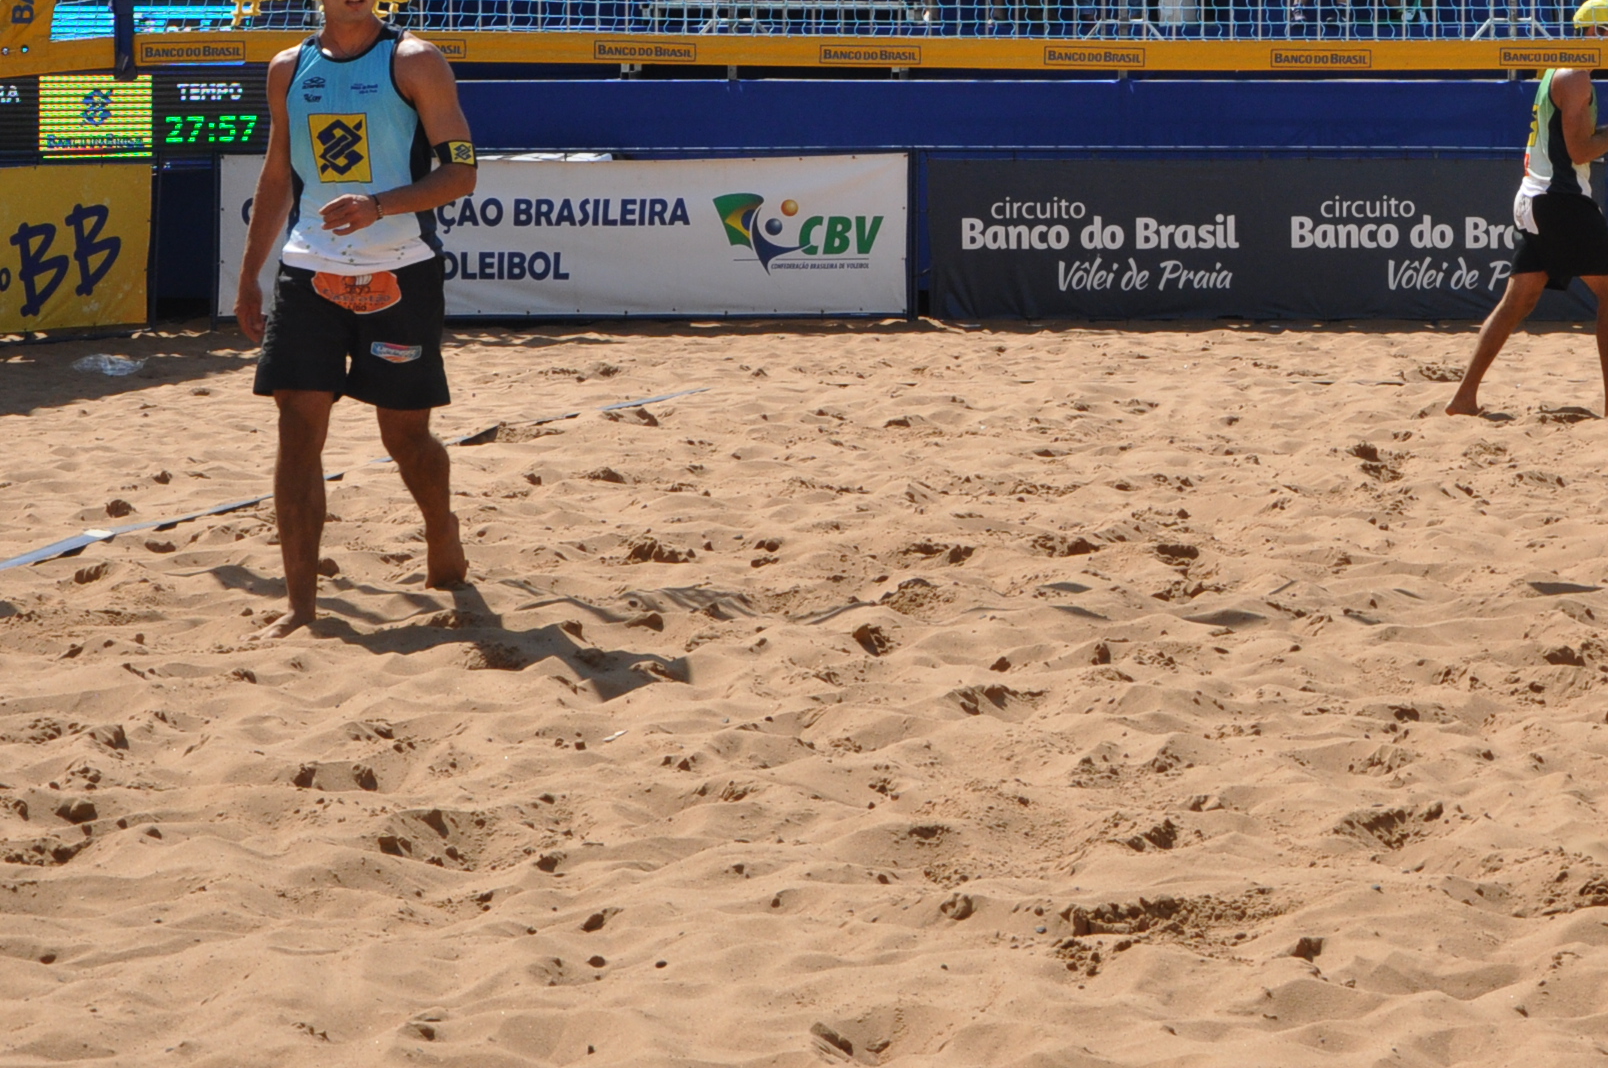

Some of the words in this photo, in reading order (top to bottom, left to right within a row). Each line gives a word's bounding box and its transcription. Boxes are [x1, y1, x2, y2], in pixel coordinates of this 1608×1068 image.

[144, 43, 185, 58] BANCO
[185, 46, 201, 59] DO
[202, 44, 242, 59] BRASIL
[597, 44, 637, 59] BANCO
[638, 47, 654, 59] DO
[654, 44, 694, 59] BRASIL
[823, 48, 863, 62] BANCO
[863, 51, 879, 62] DO
[879, 48, 919, 62] BRASIL
[1047, 50, 1086, 65] BANCO
[1087, 53, 1103, 65] DO
[1103, 50, 1142, 65] BRASIL
[1274, 51, 1313, 67] BANCO
[1314, 54, 1330, 67] DO
[1330, 51, 1369, 67] BRASIL
[1502, 50, 1542, 65] BANCO
[1542, 53, 1558, 65] DO
[1558, 50, 1598, 65] BRASIL
[177, 83, 243, 101] TEMPO
[165, 115, 258, 143] 27:57
[513, 197, 690, 227] BRASILEIRA
[991, 197, 1086, 220] circuito
[1320, 195, 1416, 219] circuito
[798, 214, 884, 255] CBV
[961, 218, 1064, 250] Banco
[1079, 215, 1125, 250] do
[1135, 214, 1239, 250] Brasil
[1290, 216, 1394, 250] Banco
[1409, 214, 1455, 250] do
[10, 203, 121, 317] BB
[444, 250, 570, 281] OLEIBOL
[1057, 257, 1118, 292] Vôlei
[1121, 258, 1150, 292] de
[1157, 258, 1233, 292] Praia
[1387, 256, 1447, 291] Vôlei
[1450, 257, 1479, 291] de
